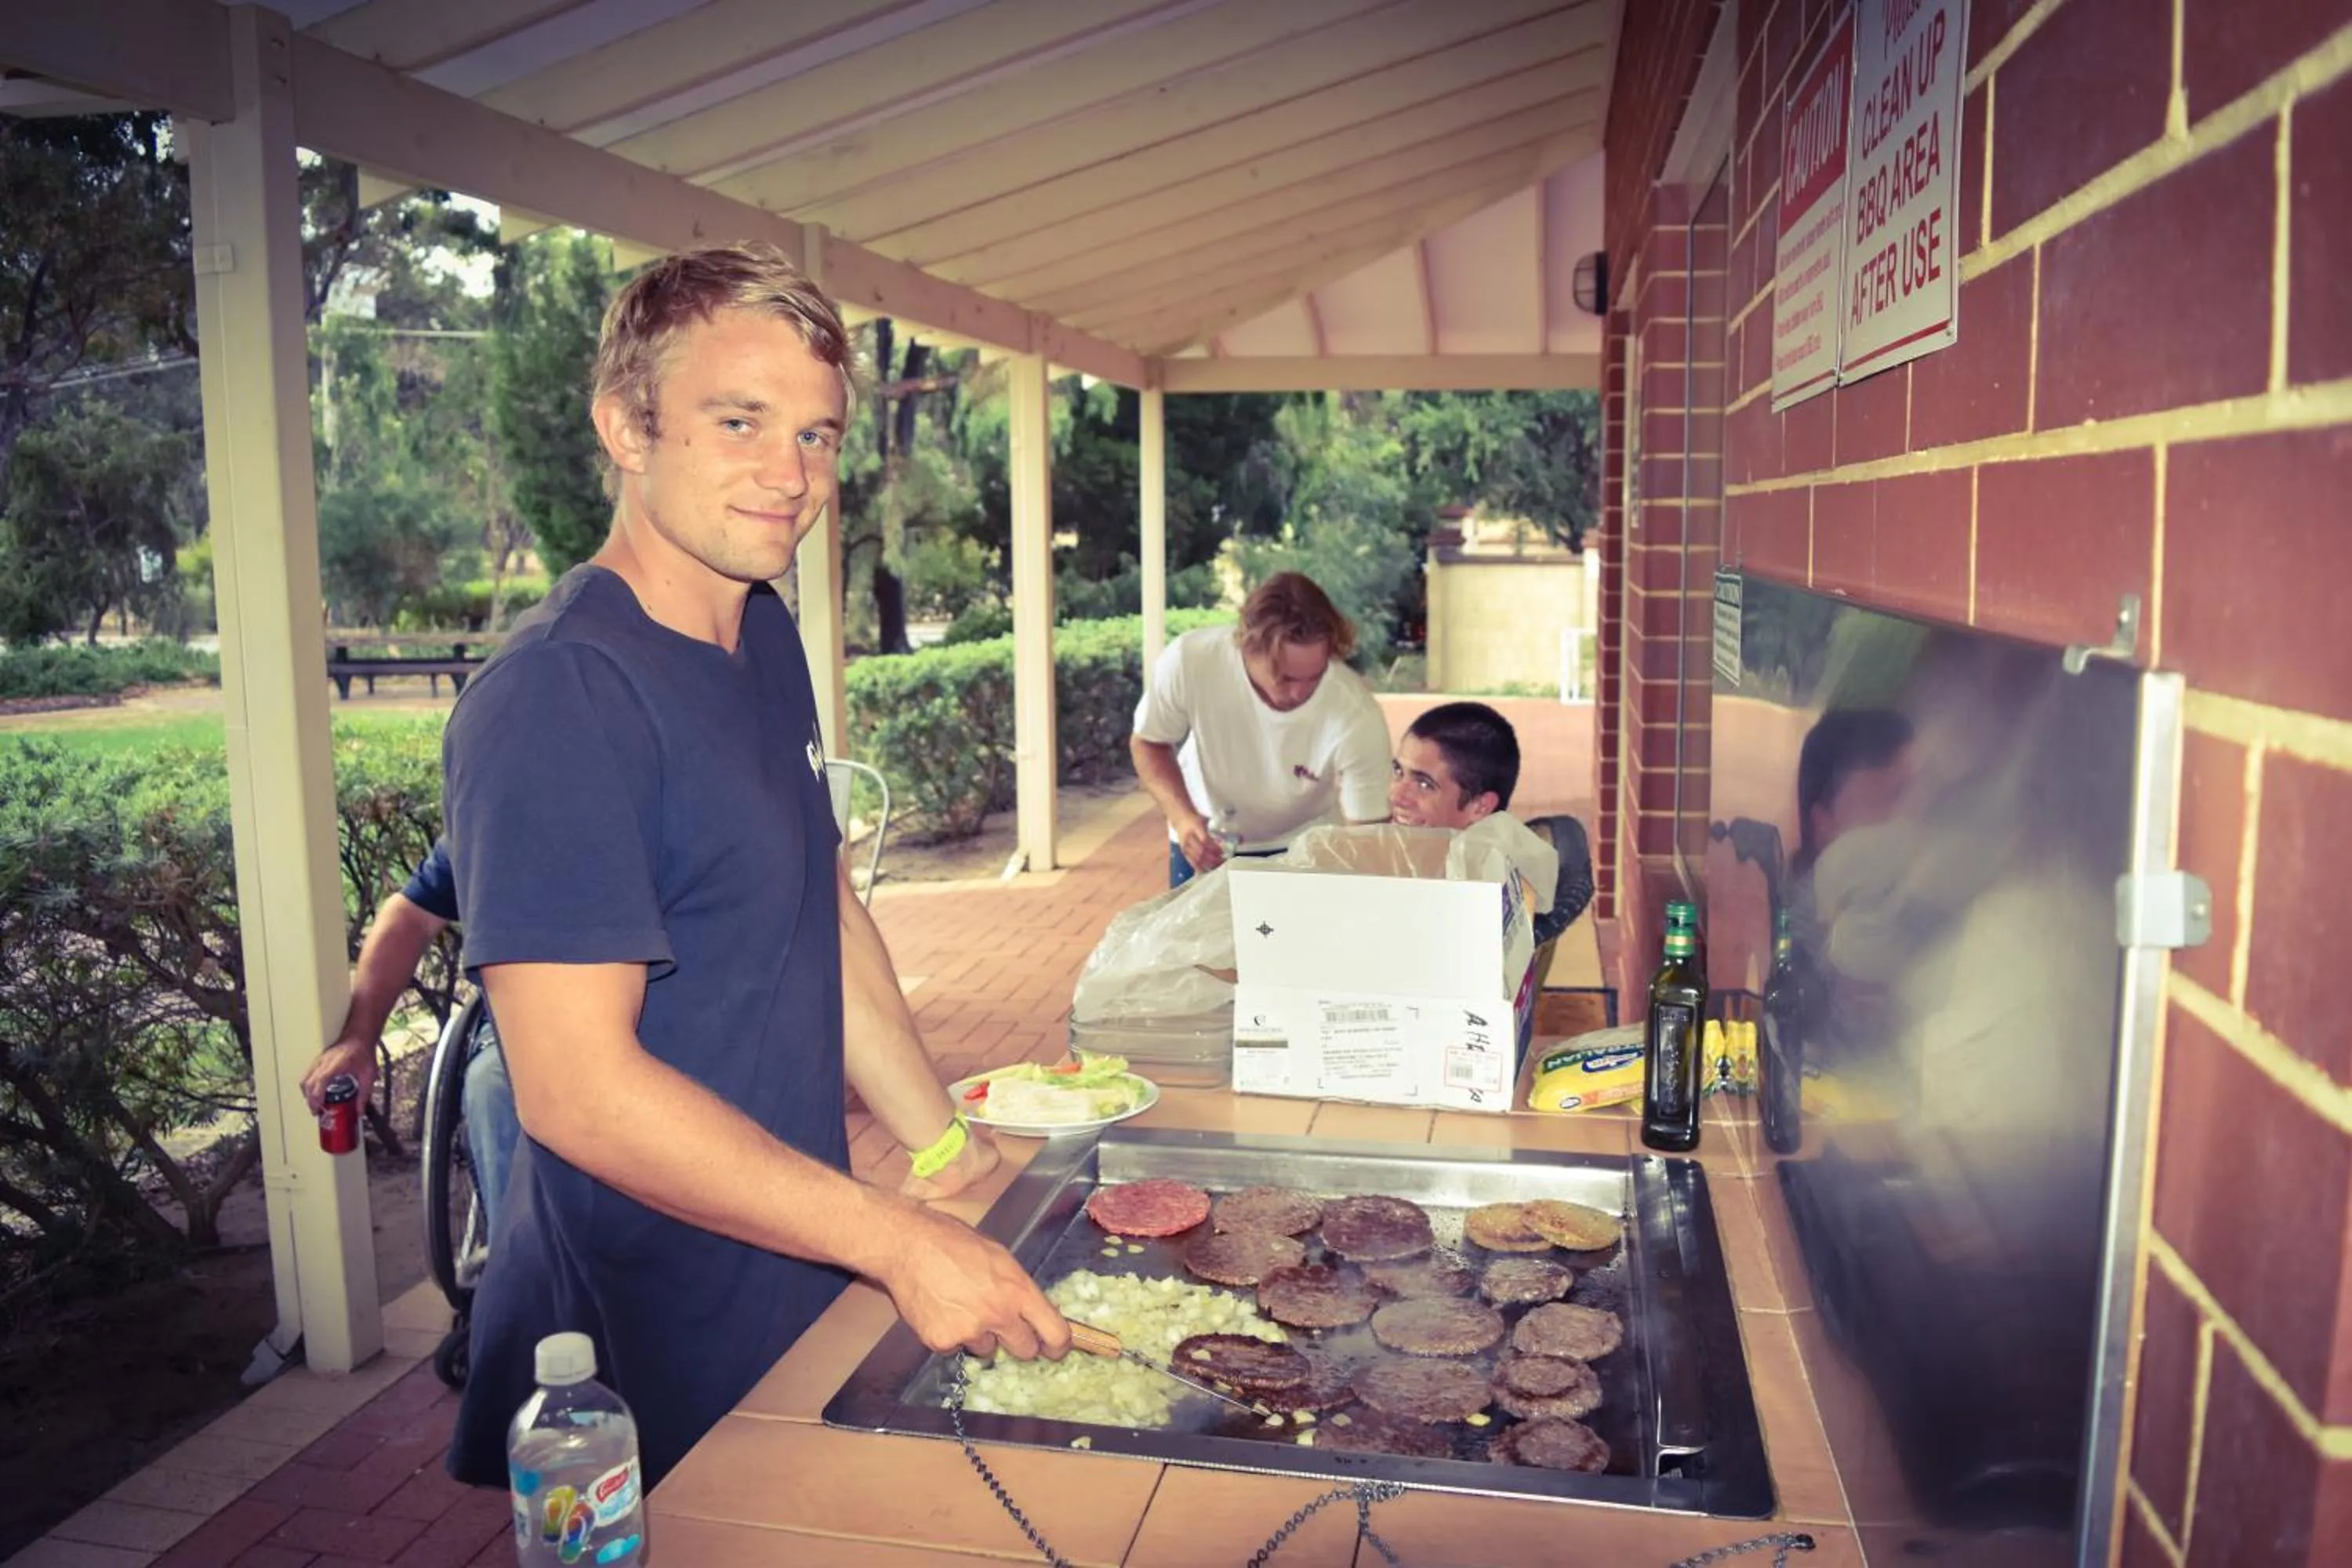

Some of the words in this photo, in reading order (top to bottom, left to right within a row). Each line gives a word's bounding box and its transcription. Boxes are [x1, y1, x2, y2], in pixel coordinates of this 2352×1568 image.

[1785, 54, 1845, 205] CAUTION
[1862, 45, 1914, 160] CLEAN
[1918, 8, 1946, 96] UP
[1857, 164, 1888, 246] BBQ
[1889, 111, 1940, 218] AREA
[1849, 241, 1898, 330] AFTER
[1902, 207, 1941, 297] USE
